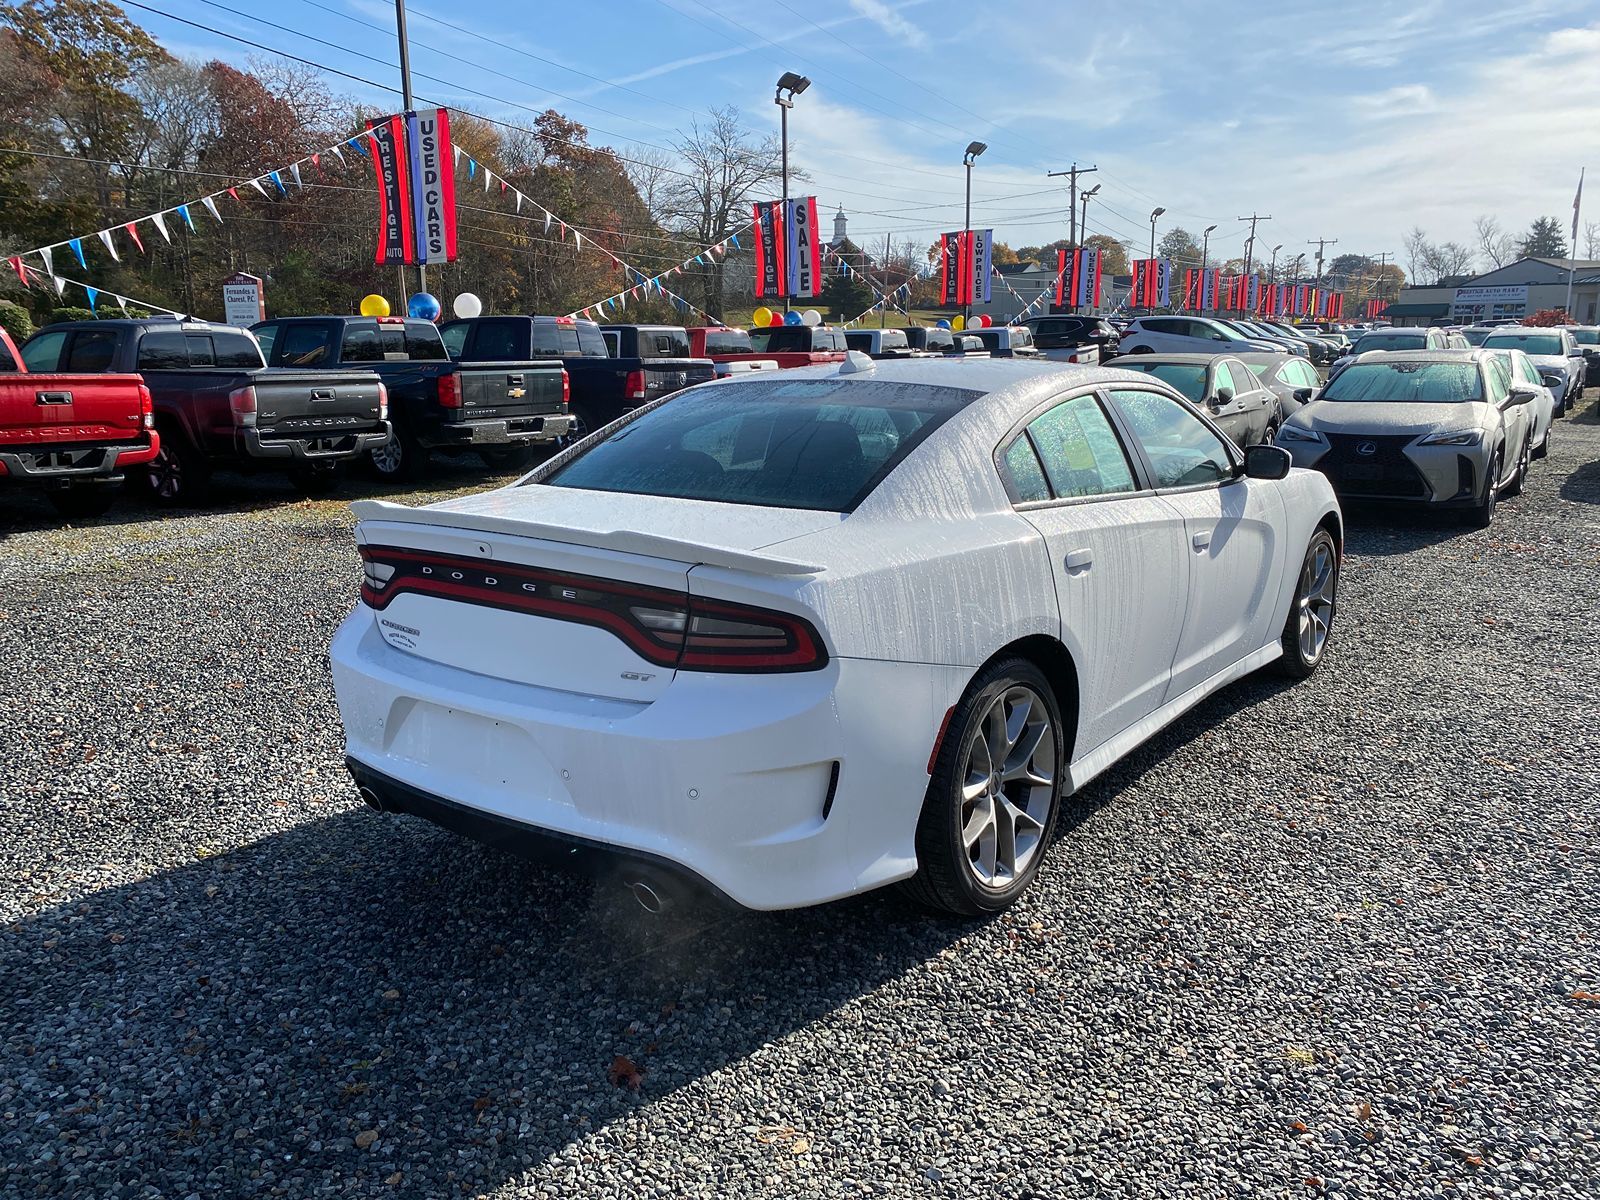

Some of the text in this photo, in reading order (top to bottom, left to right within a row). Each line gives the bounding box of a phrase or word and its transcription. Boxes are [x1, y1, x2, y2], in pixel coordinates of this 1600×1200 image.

[378, 127, 398, 240] PRESTIGE
[421, 120, 442, 254] USED CARS
[386, 247, 402, 258] AUTO
[796, 204, 810, 290] SALE
[975, 235, 984, 299] LOW PRICES
[1085, 252, 1096, 304] USED TRUCKS
[0, 427, 108, 438] TACOMA
[286, 417, 357, 427] TACOMA
[422, 566, 577, 599] DODGE
[620, 671, 656, 681] GT
